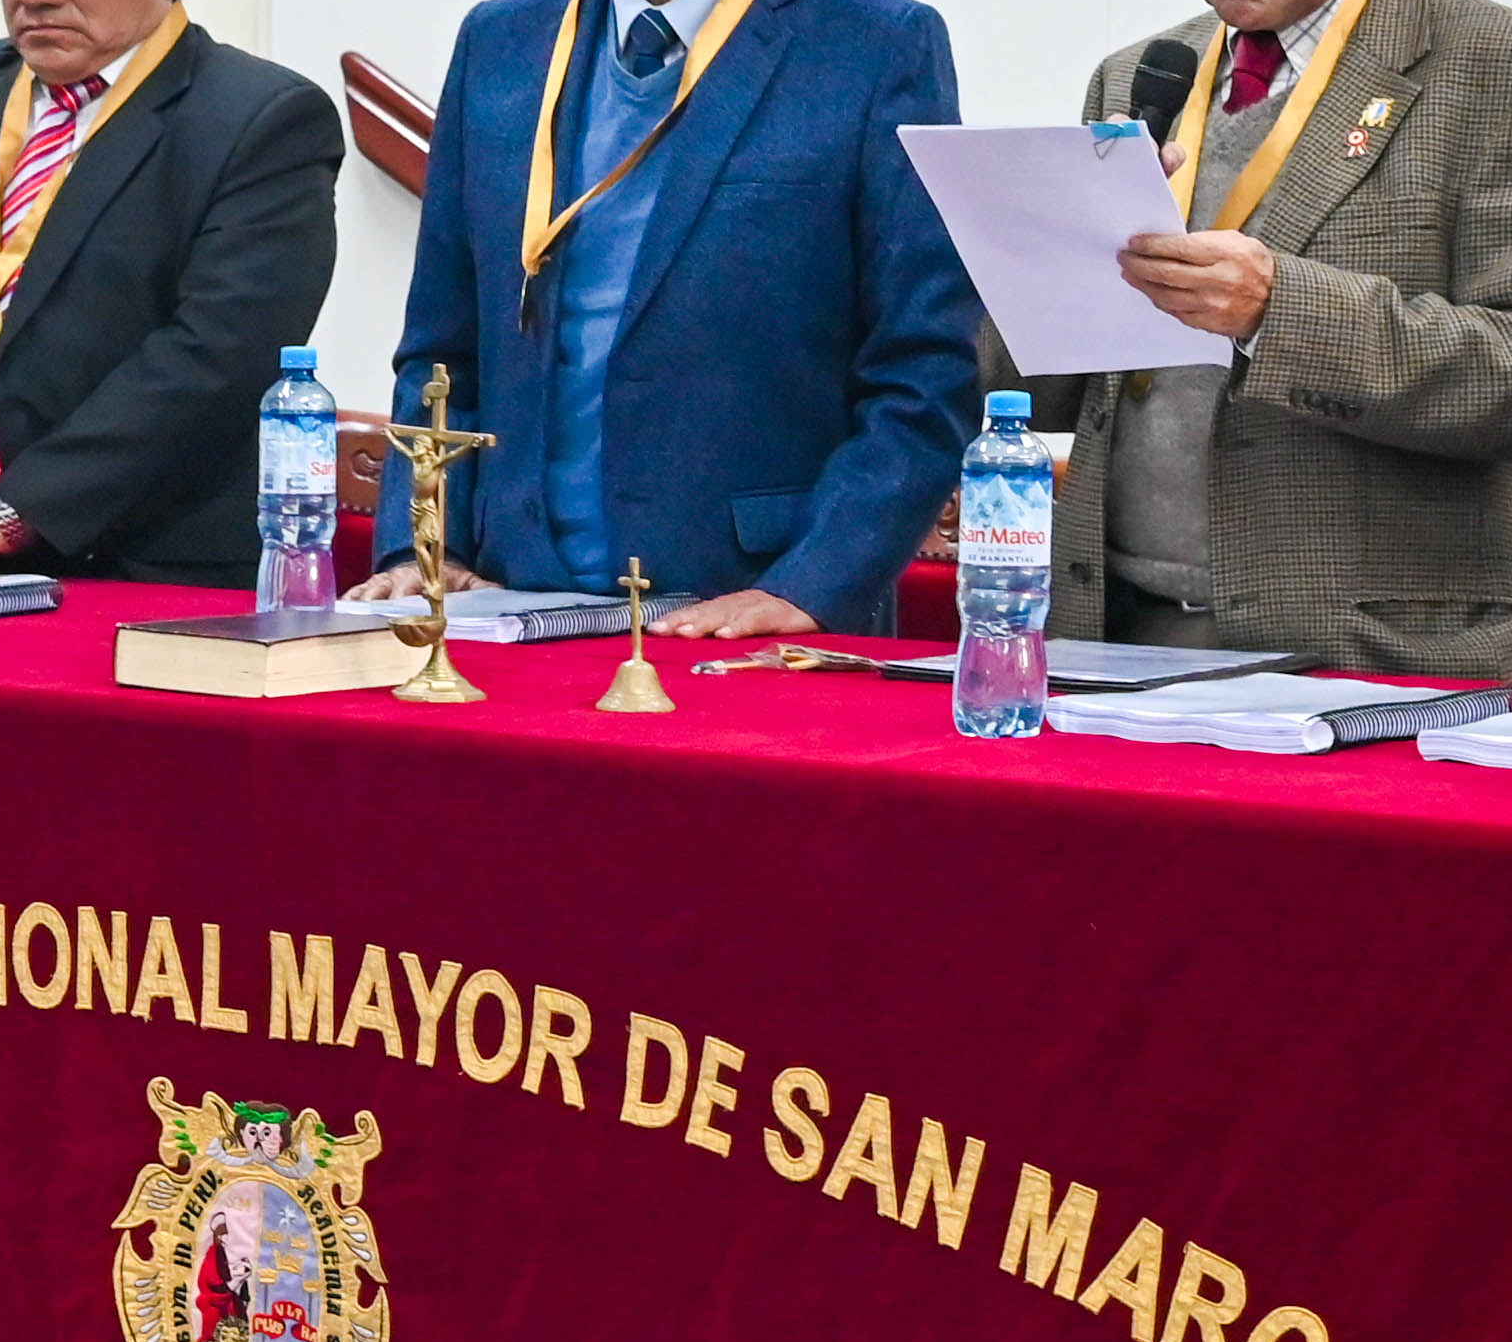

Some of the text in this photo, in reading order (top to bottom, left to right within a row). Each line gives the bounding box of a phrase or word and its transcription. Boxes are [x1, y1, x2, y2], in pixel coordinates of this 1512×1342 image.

[991, 527, 1046, 546] Mateo
[267, 929, 593, 1111] MAYOR
[619, 1010, 746, 1159] DE
[762, 1065, 986, 1251] SAN
